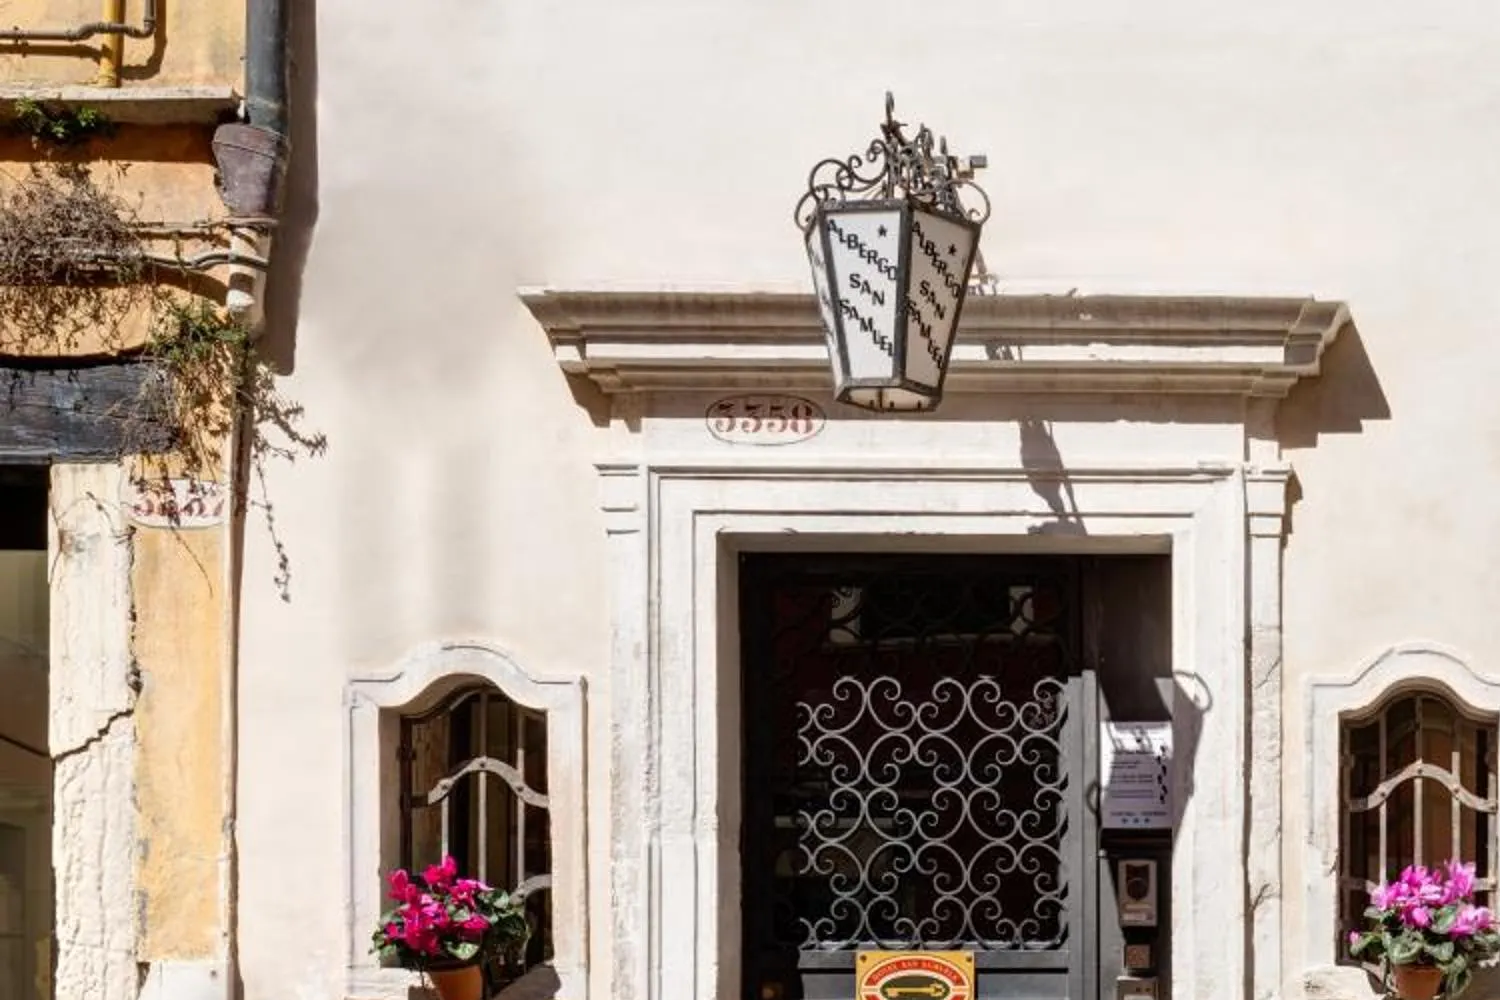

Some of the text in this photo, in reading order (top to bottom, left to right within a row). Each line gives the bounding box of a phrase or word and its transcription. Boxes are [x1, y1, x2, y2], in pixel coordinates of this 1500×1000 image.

[827, 218, 898, 281] ALBERGO
[911, 221, 960, 300] ALBERGO
[849, 273, 885, 306] SAN
[919, 279, 946, 320] SAN
